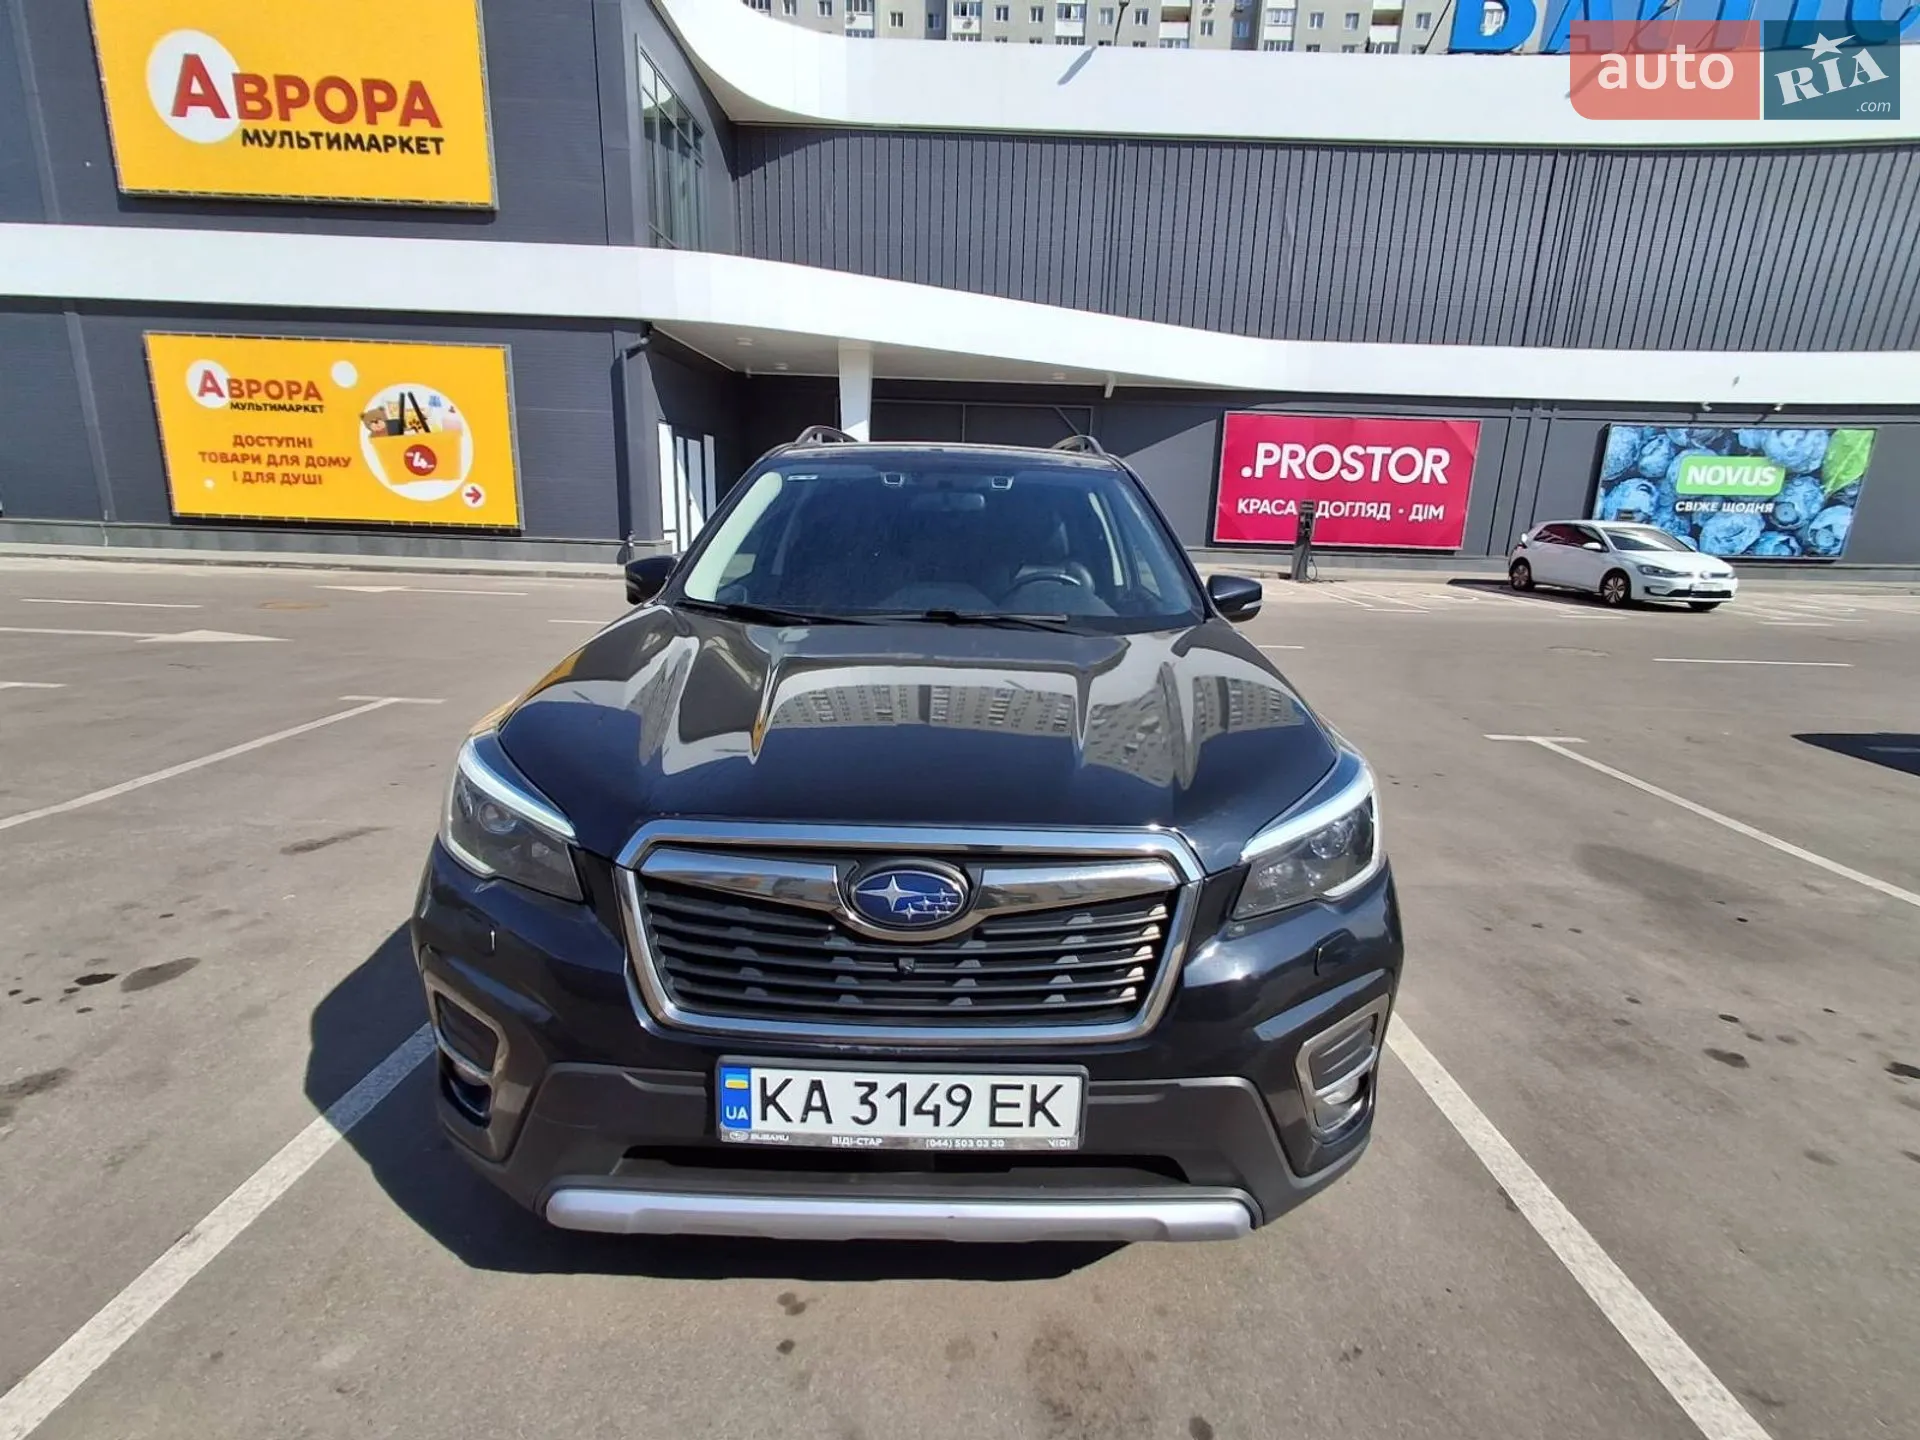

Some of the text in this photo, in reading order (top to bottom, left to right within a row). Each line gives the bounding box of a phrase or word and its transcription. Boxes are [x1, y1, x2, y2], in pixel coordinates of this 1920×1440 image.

[241, 129, 444, 155] МУЛЬТИМАРКЕТ
[230, 402, 324, 414] МУЛЬТИМАРКЕТ
[232, 435, 313, 448] ДОСТУПНІ
[198, 451, 352, 468] ТОВАРИ ДЛЯ ДОМУ
[1241, 442, 1450, 484] .PROSTOR
[242, 471, 276, 484] ДЛЯ
[280, 473, 323, 486] ДУШІ
[1686, 465, 1777, 487] NOVUS
[1237, 498, 1445, 521] КРАСА ДОГЛЯД ДІМ
[1675, 501, 1775, 514] СВІЖЕ ЩОДНЯ
[759, 1076, 1064, 1128] KA 3149 EK
[725, 1106, 749, 1120] UA
